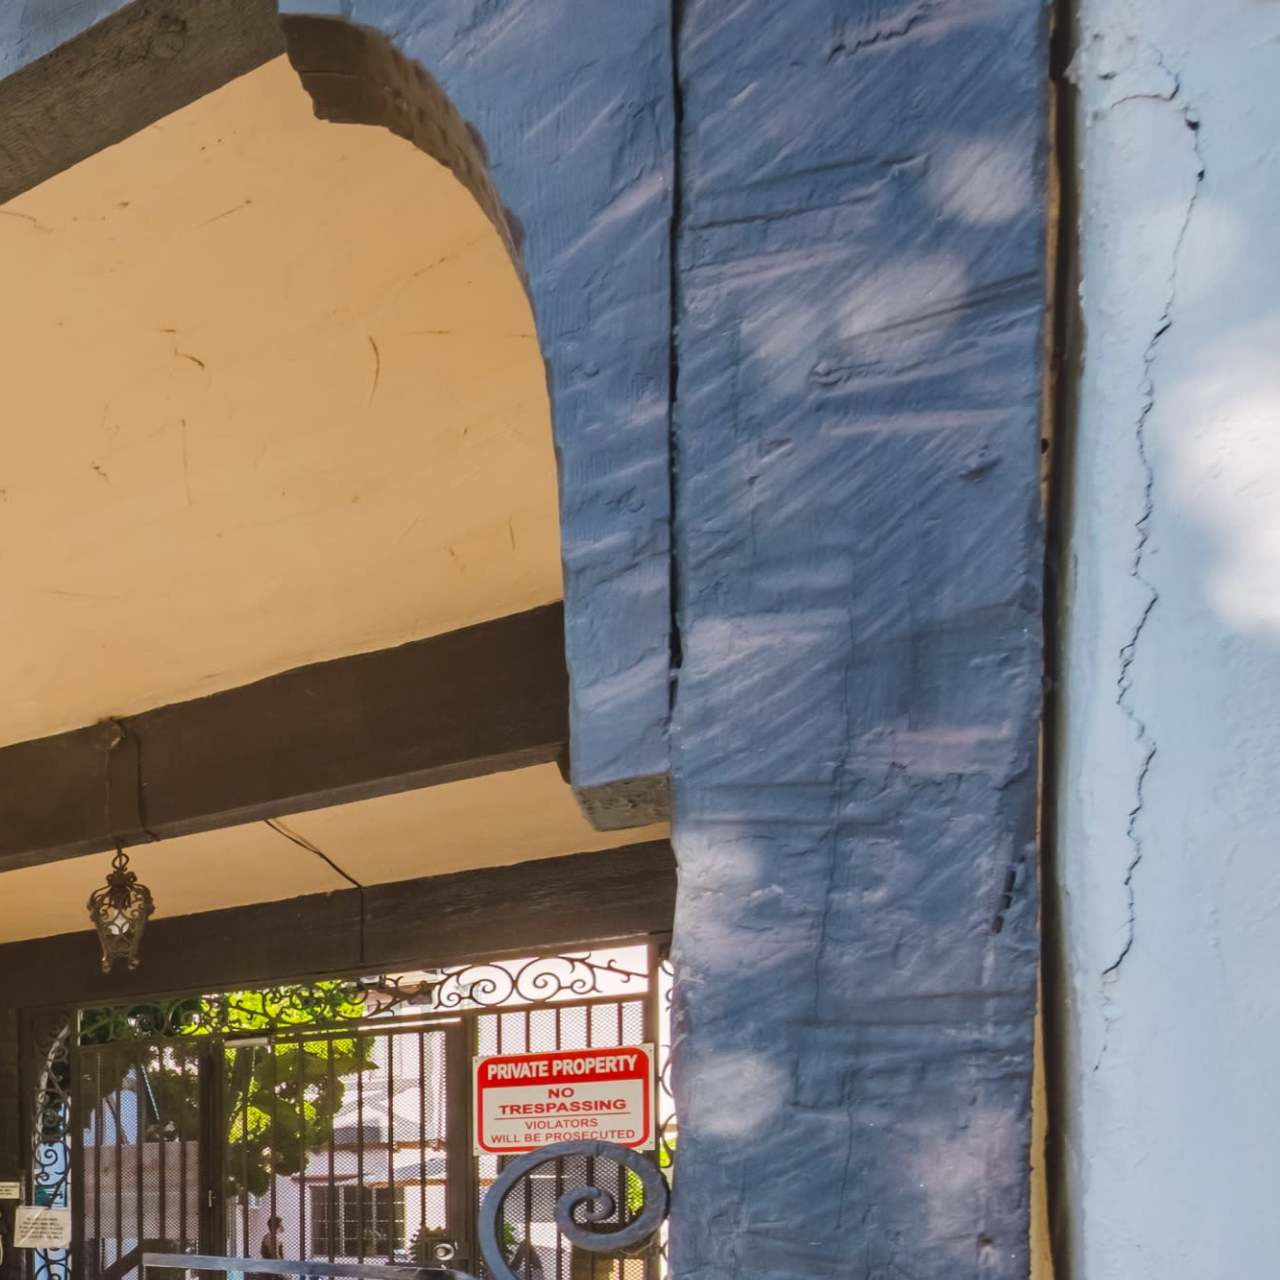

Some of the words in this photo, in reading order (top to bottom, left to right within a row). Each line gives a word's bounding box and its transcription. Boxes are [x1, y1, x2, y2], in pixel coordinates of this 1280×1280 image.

[487, 1060, 549, 1081] PRIVATE
[552, 1054, 638, 1076] PROPERTY
[548, 1087, 575, 1099] NO
[498, 1099, 627, 1115] TRESPASSING
[525, 1118, 599, 1130] VIOLATORS
[491, 1134, 520, 1143] WILL
[524, 1133, 542, 1142] BE
[545, 1129, 636, 1142] PROSECUTED
